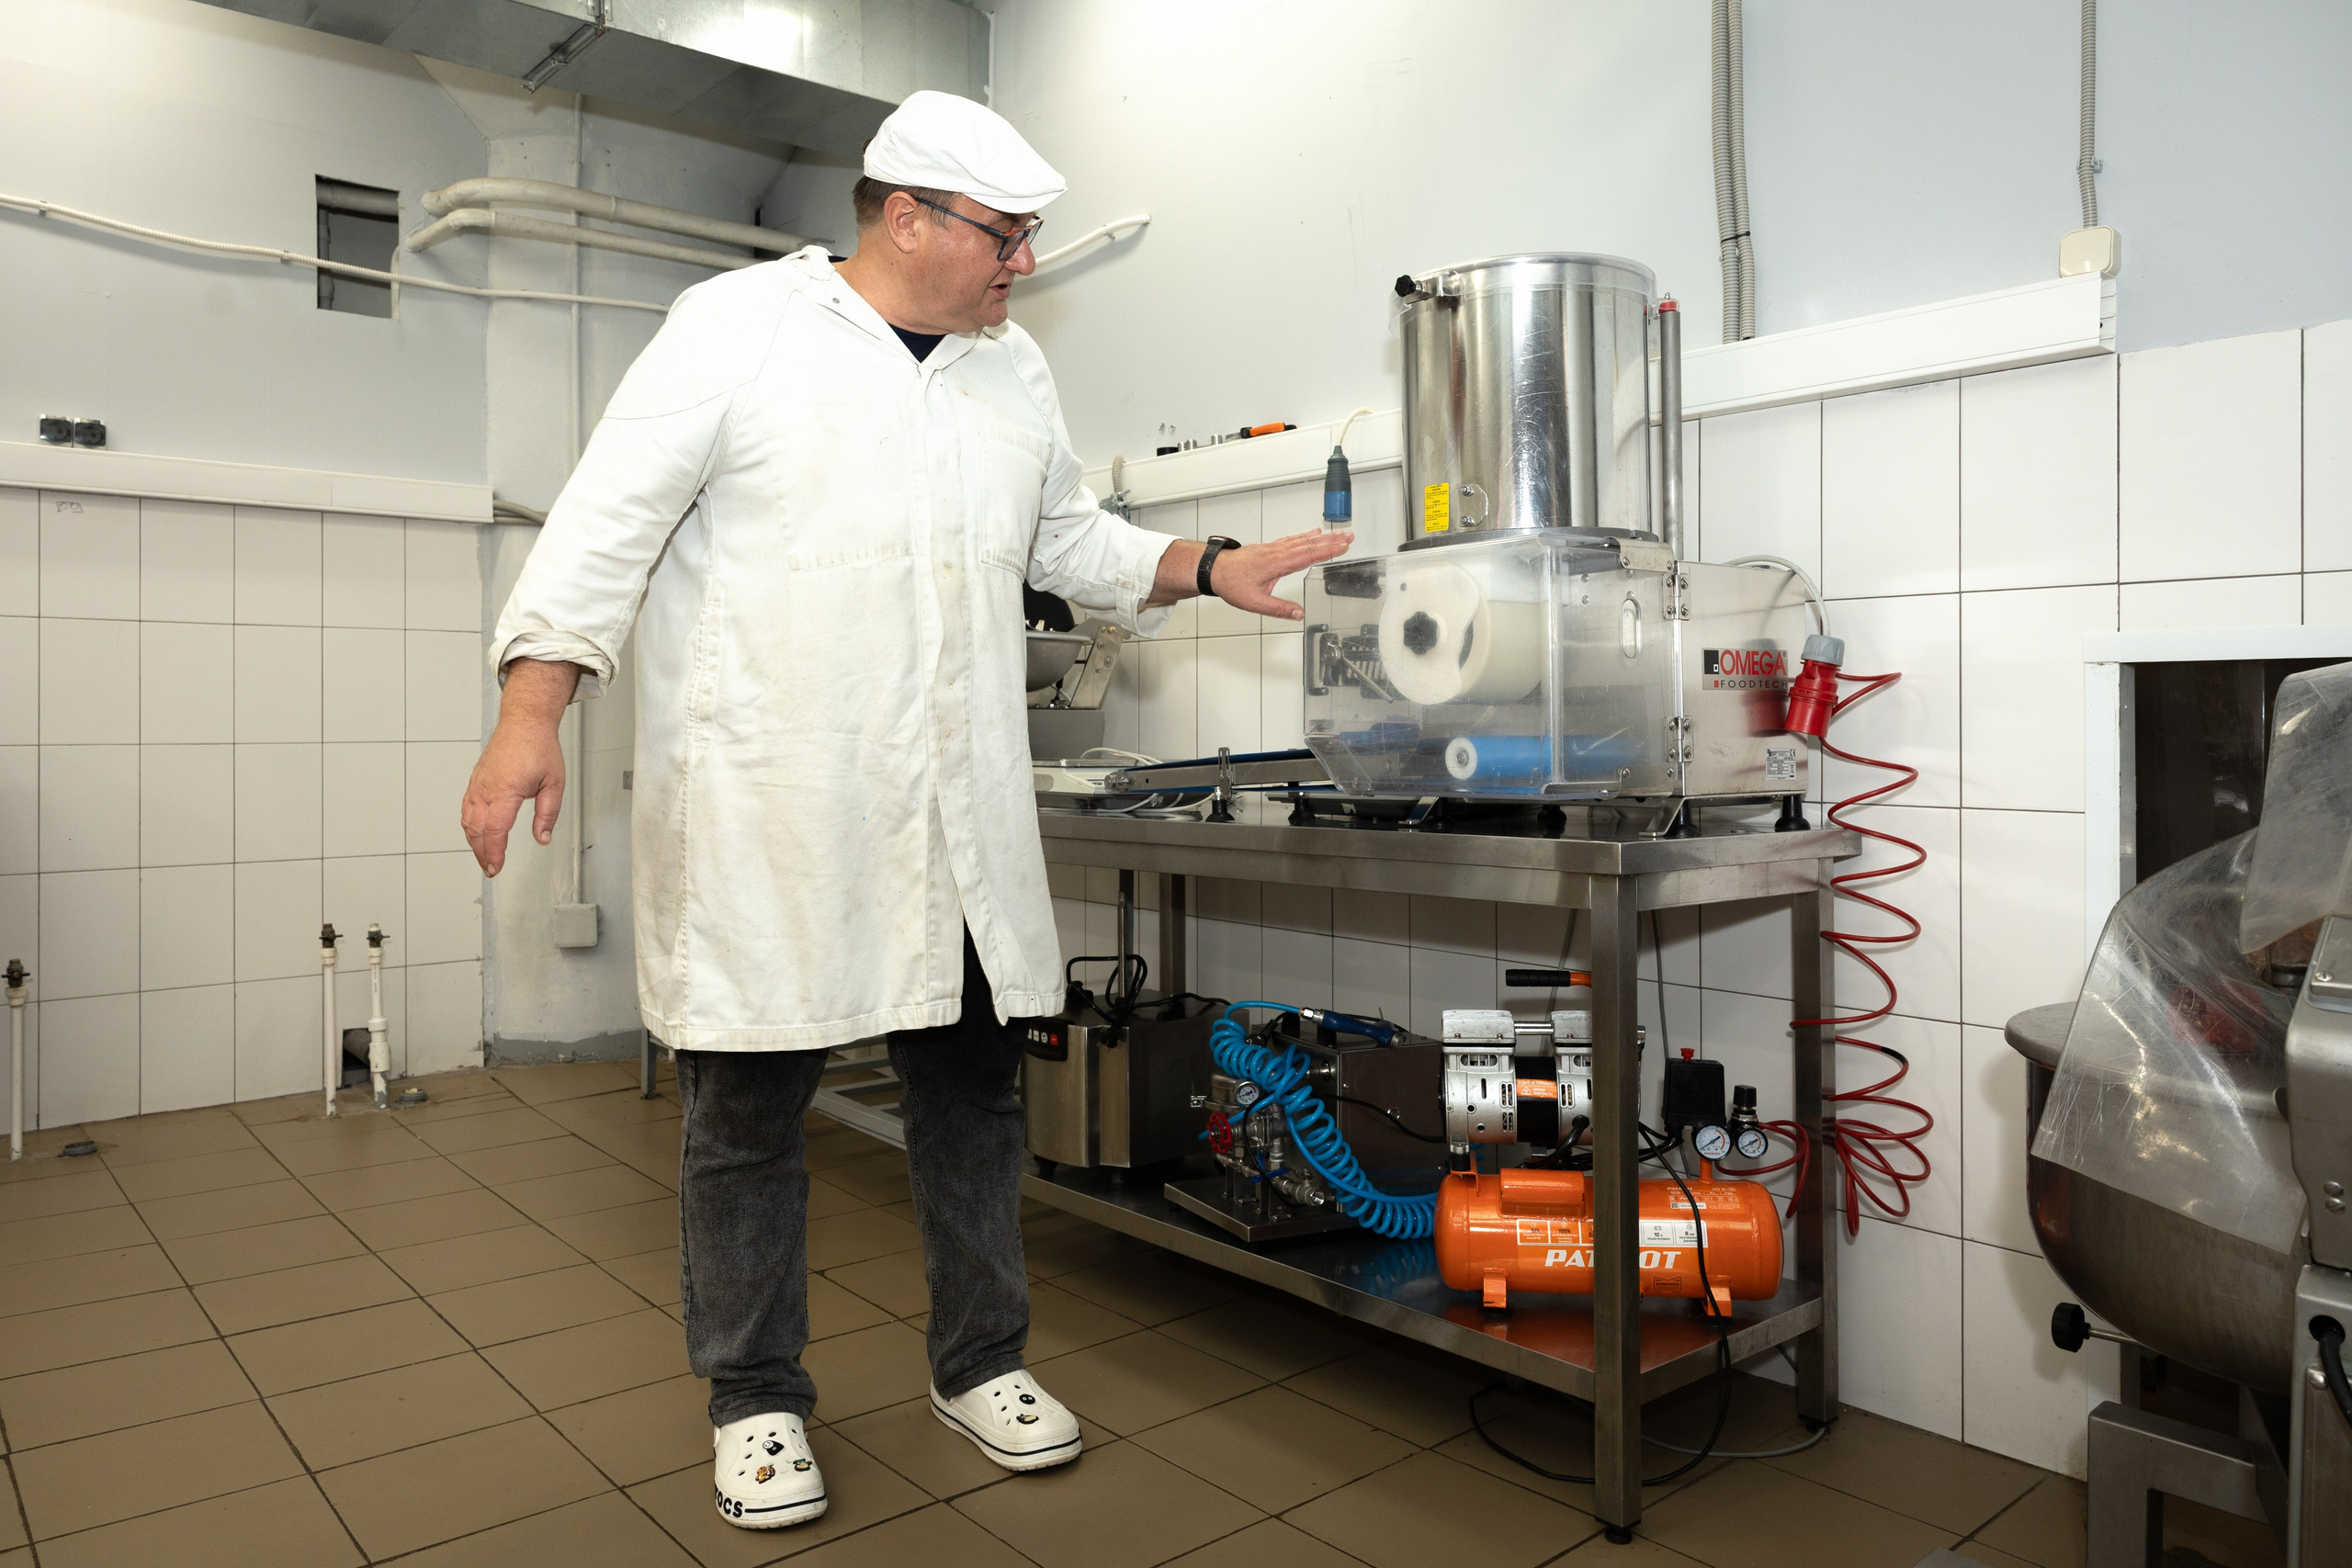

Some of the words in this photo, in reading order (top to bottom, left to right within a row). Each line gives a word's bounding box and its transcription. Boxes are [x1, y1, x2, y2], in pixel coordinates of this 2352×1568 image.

[1720, 649, 1786, 675] OMEGA
[1720, 680, 1788, 688] FOODTECH
[1544, 1249, 1681, 1269] PATOT
